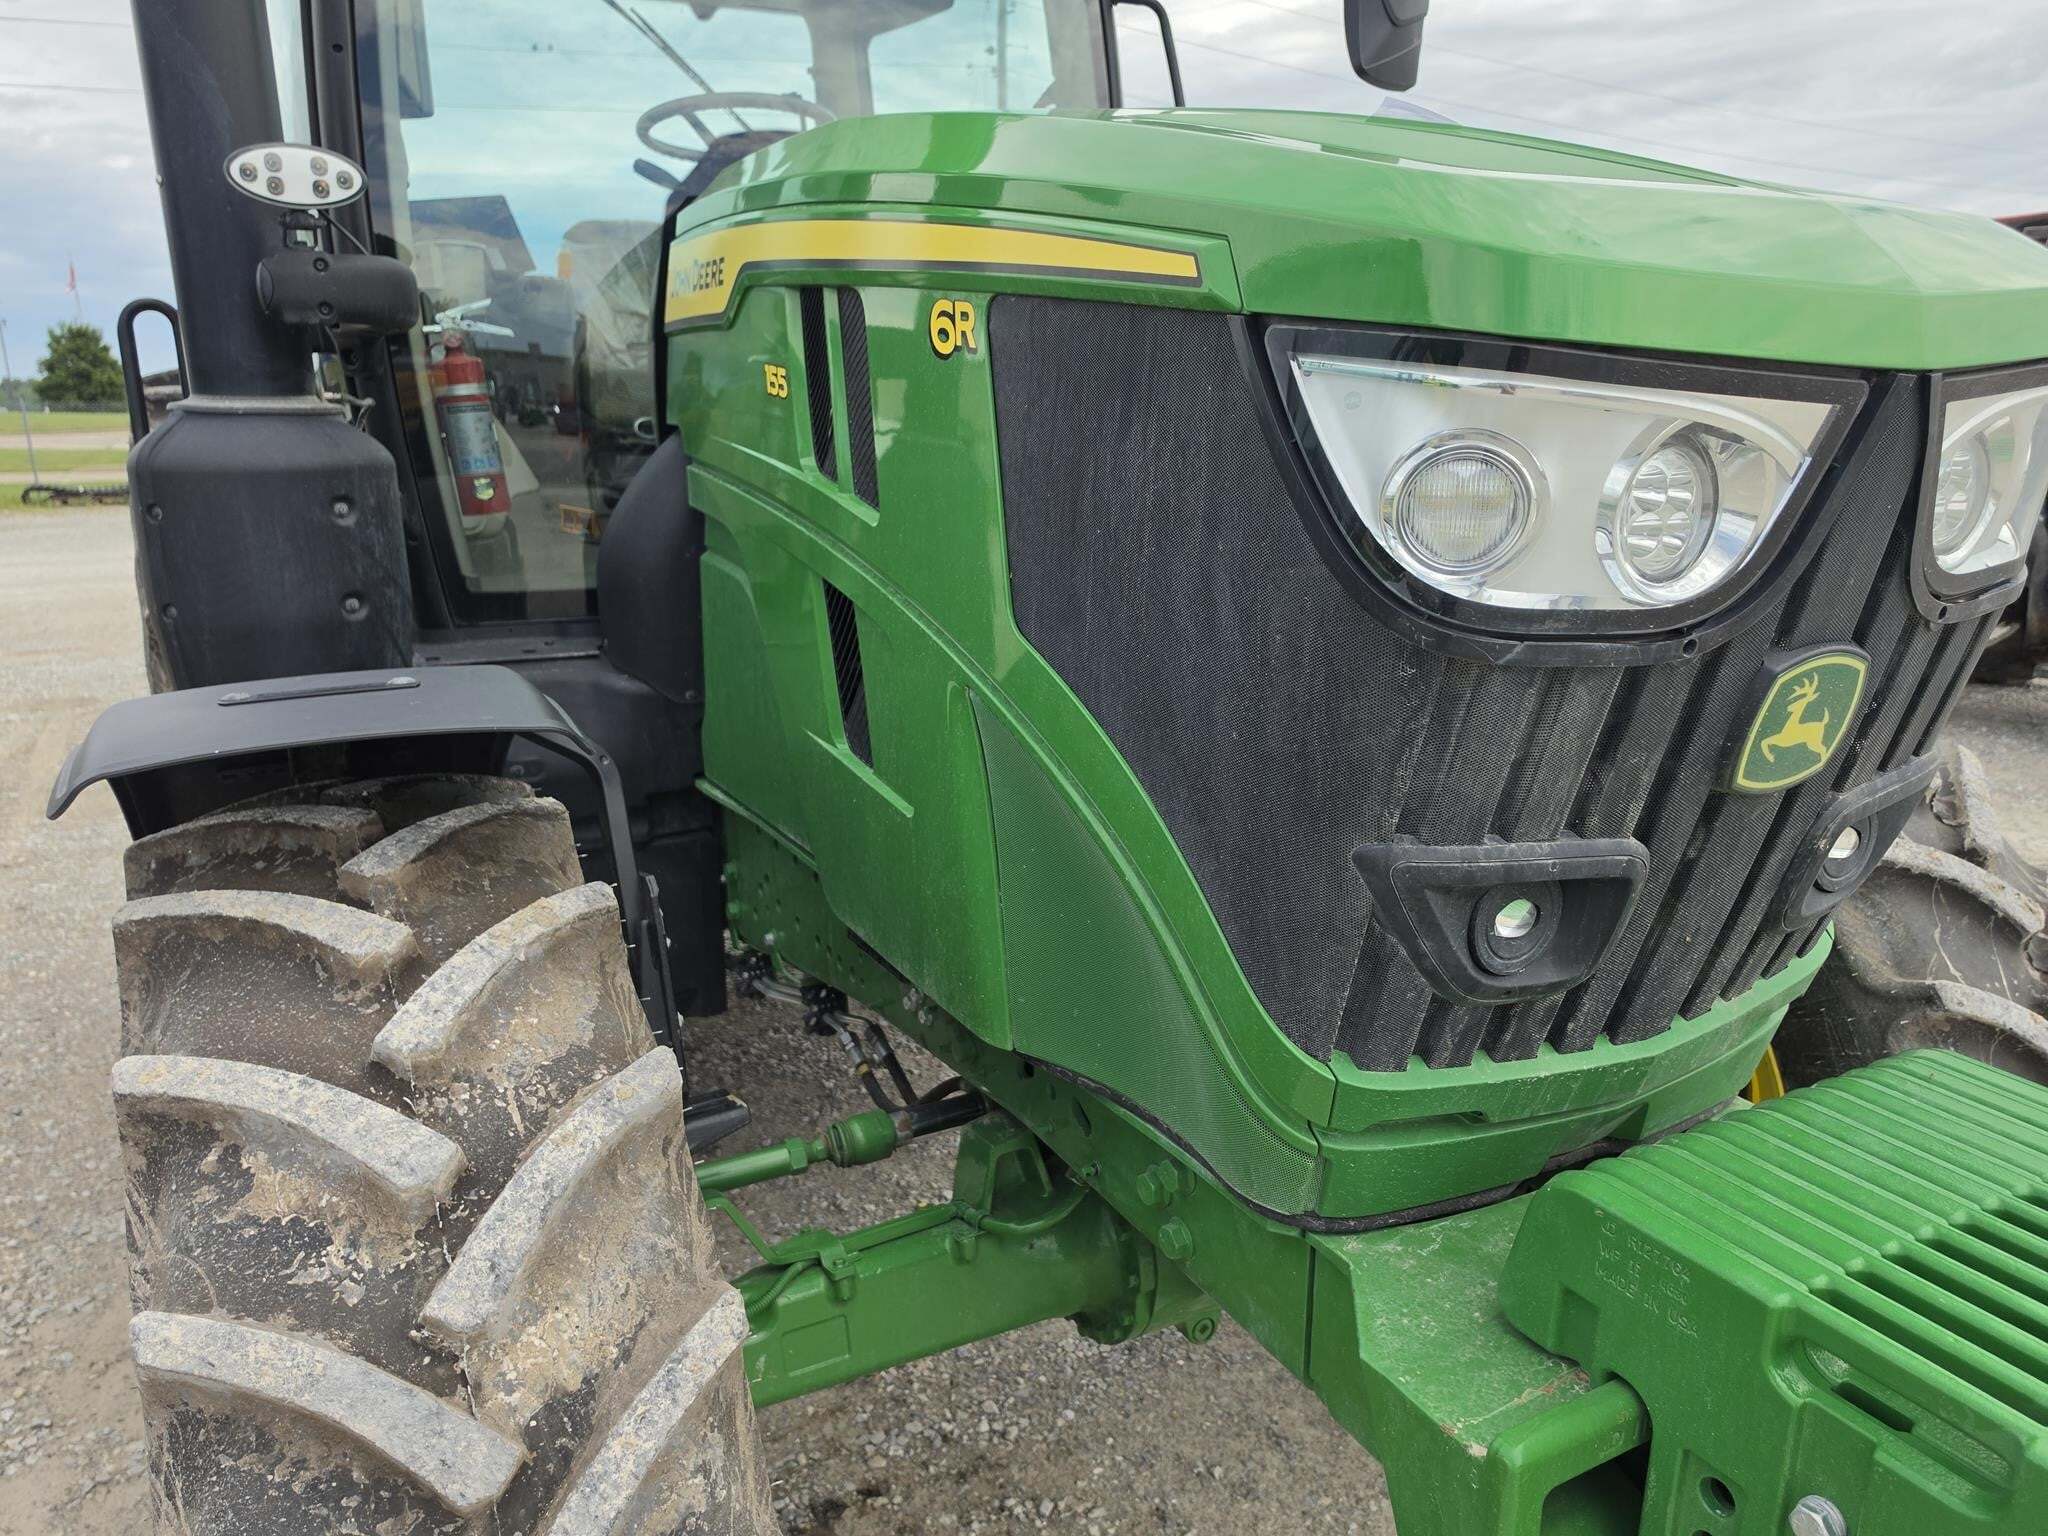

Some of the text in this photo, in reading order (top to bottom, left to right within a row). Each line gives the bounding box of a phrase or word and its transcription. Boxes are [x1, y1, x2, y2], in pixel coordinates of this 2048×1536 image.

[692, 256, 725, 292] DEERE
[929, 298, 977, 360] 6R
[763, 363, 789, 400] 155
[1595, 1259, 1637, 1299] MADE
[1666, 1308, 1699, 1339] USA
